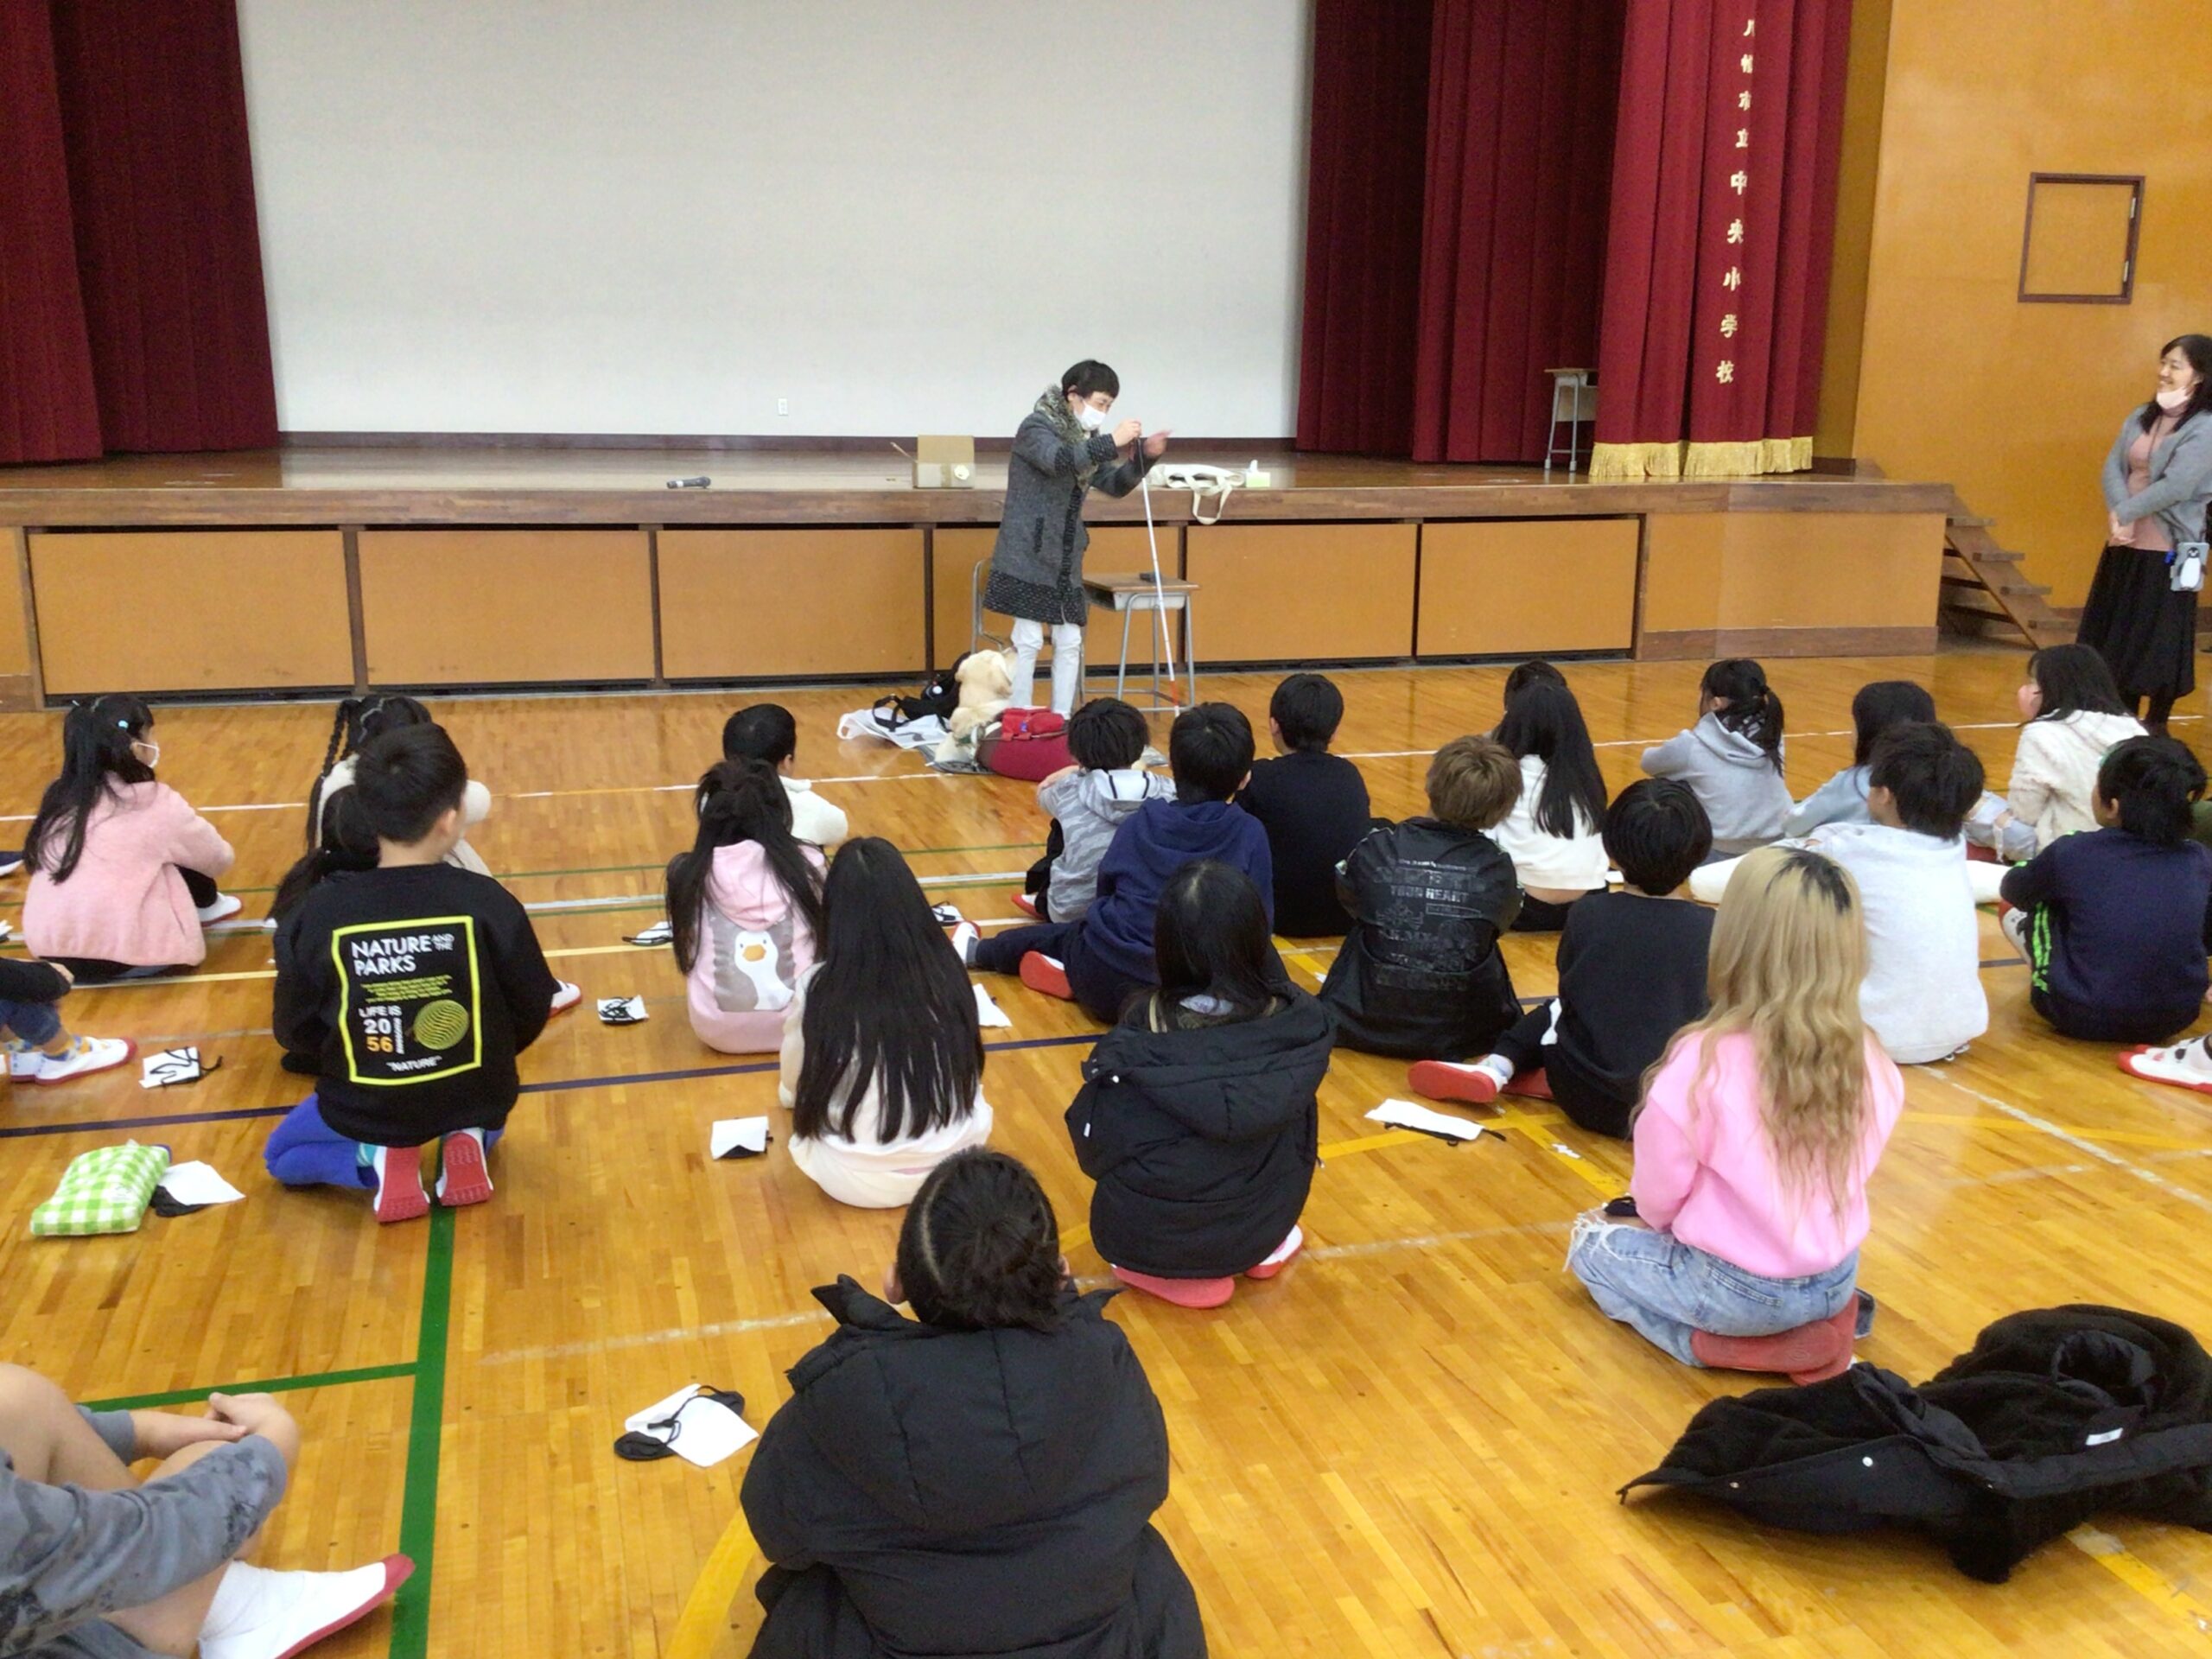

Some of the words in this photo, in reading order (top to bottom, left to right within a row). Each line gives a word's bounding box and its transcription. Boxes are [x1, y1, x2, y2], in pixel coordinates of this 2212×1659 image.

[431, 933, 454, 943] AND
[351, 935, 433, 959] NATURE
[353, 955, 416, 976] PARKS
[358, 1005, 388, 1018] LIFE
[388, 1005, 403, 1016] IS
[363, 1018, 392, 1034] 20
[366, 1036, 394, 1053] 56
